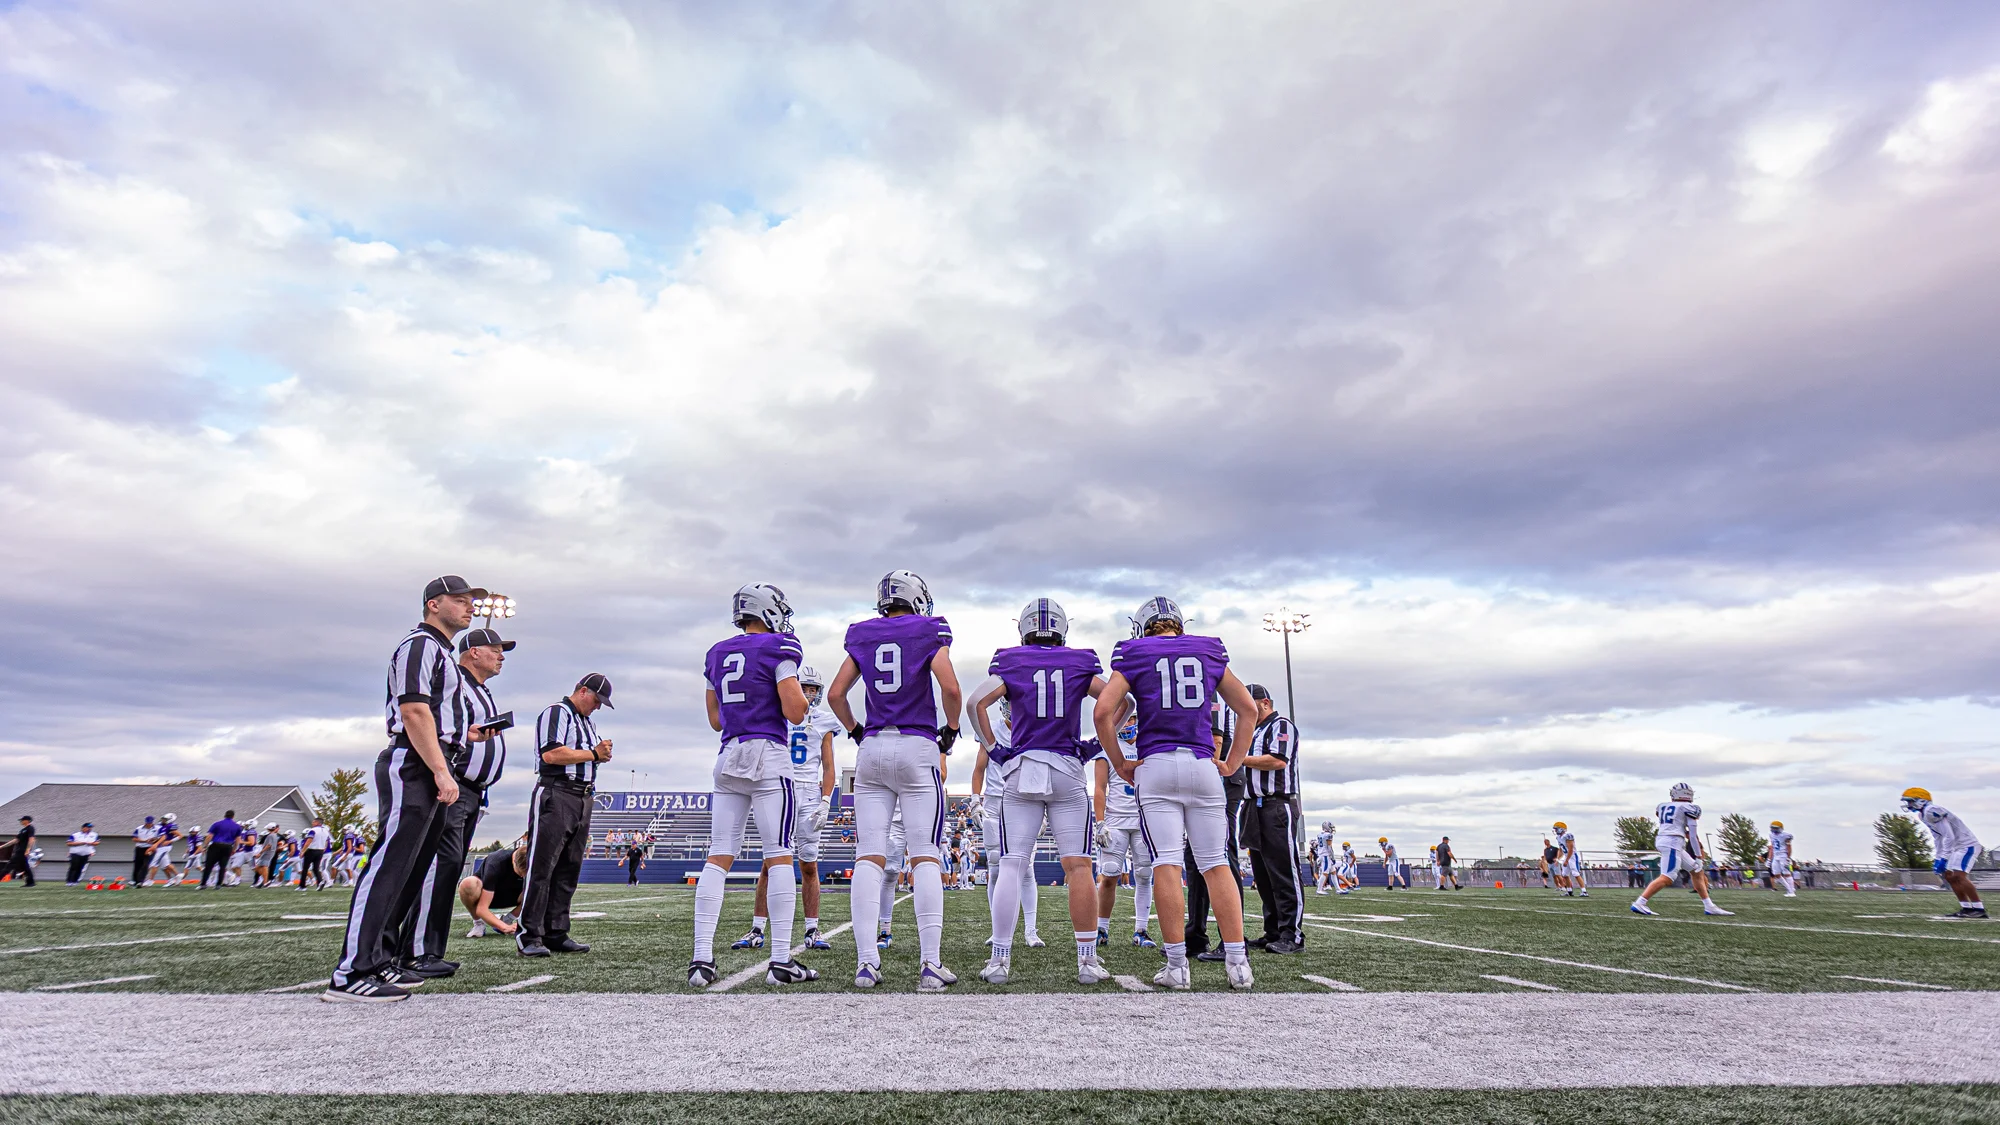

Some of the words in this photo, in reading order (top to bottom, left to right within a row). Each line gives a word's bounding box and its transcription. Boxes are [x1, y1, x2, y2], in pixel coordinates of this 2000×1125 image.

[722, 652, 746, 704] 2
[874, 642, 902, 694] 9
[1155, 656, 1205, 710] 18
[1033, 669, 1065, 718] 11
[791, 732, 808, 764] 6
[625, 795, 708, 809] BUFFALO
[1660, 805, 1676, 825] 12
